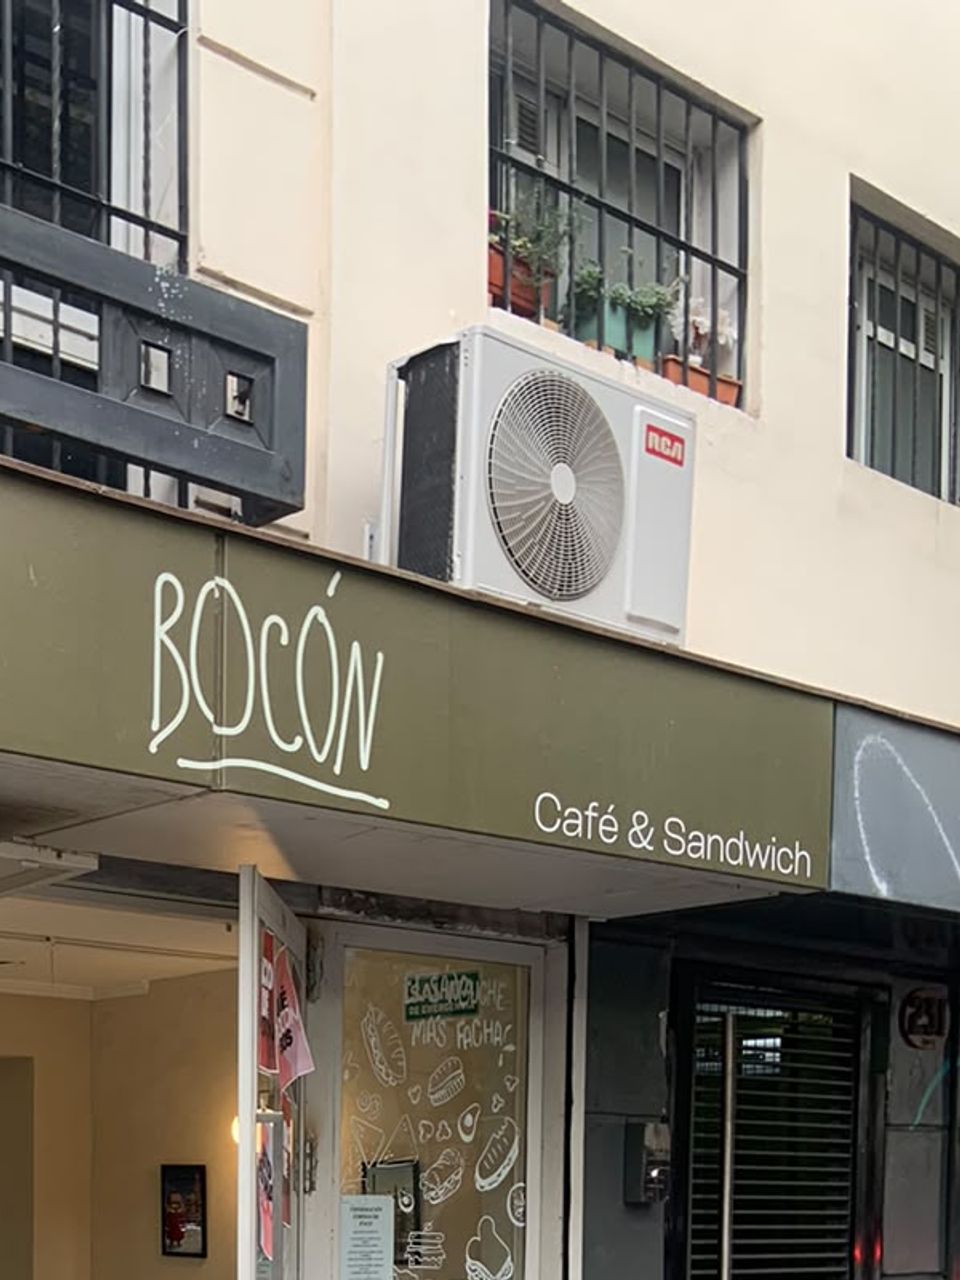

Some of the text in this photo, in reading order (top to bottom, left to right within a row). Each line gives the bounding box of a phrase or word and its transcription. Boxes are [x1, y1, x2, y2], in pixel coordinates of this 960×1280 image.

[647, 430, 683, 462] RCA
[148, 571, 385, 776] BOCÓN
[534, 791, 812, 878] Café & Sandwich
